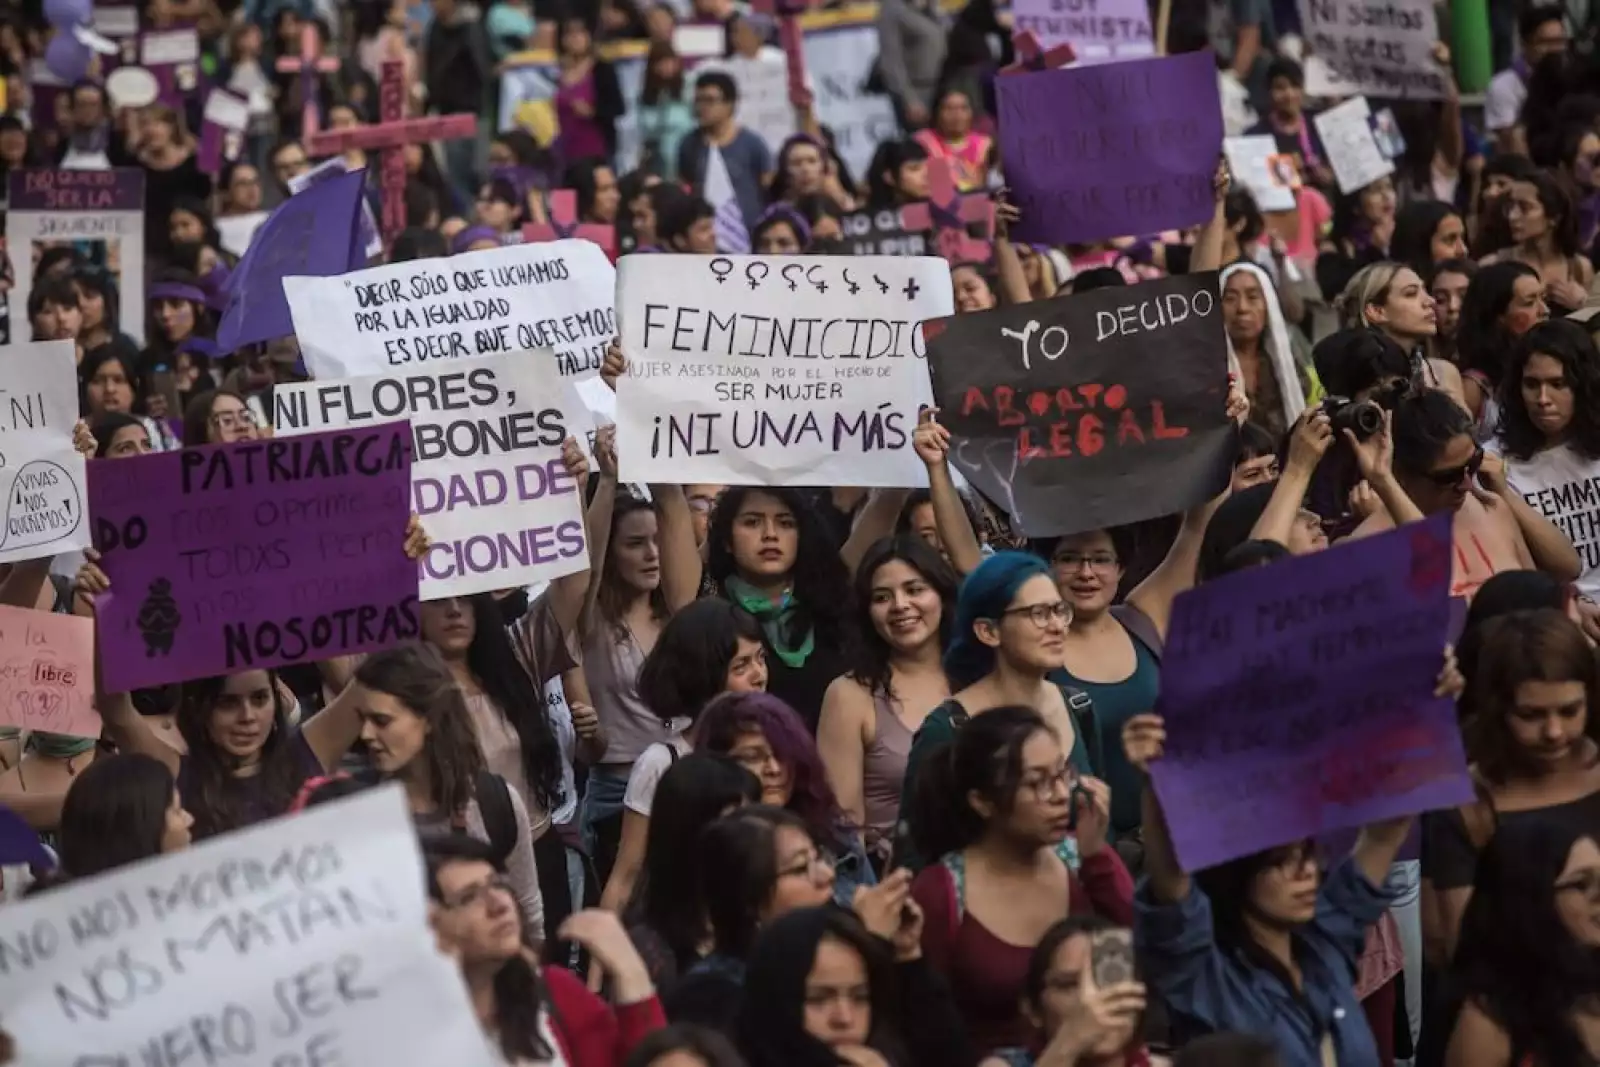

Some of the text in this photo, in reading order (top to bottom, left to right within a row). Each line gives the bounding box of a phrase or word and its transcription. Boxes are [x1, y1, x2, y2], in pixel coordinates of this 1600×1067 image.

[453, 268, 488, 294] QUE
[490, 258, 570, 287] LUCHAMOS
[354, 298, 511, 334] POR LA IGUALDAD
[1001, 289, 1214, 370] YO DECIDO
[385, 340, 413, 366] ES
[414, 332, 471, 362] DECIR
[474, 325, 512, 353] QUE
[714, 381, 843, 401] SER MUJER
[771, 366, 796, 378] POR
[805, 366, 821, 379] EL
[275, 391, 310, 430] NI
[963, 384, 1127, 424] ABORTO
[651, 411, 722, 459] ¡NI
[732, 410, 824, 448] UNA
[1018, 400, 1190, 460] LEGAL
[23, 492, 48, 513] NOS
[96, 515, 148, 554] DO
[222, 593, 422, 670] NOSOTRAS
[54, 948, 163, 1023] NOS
[270, 952, 380, 1040] SER
